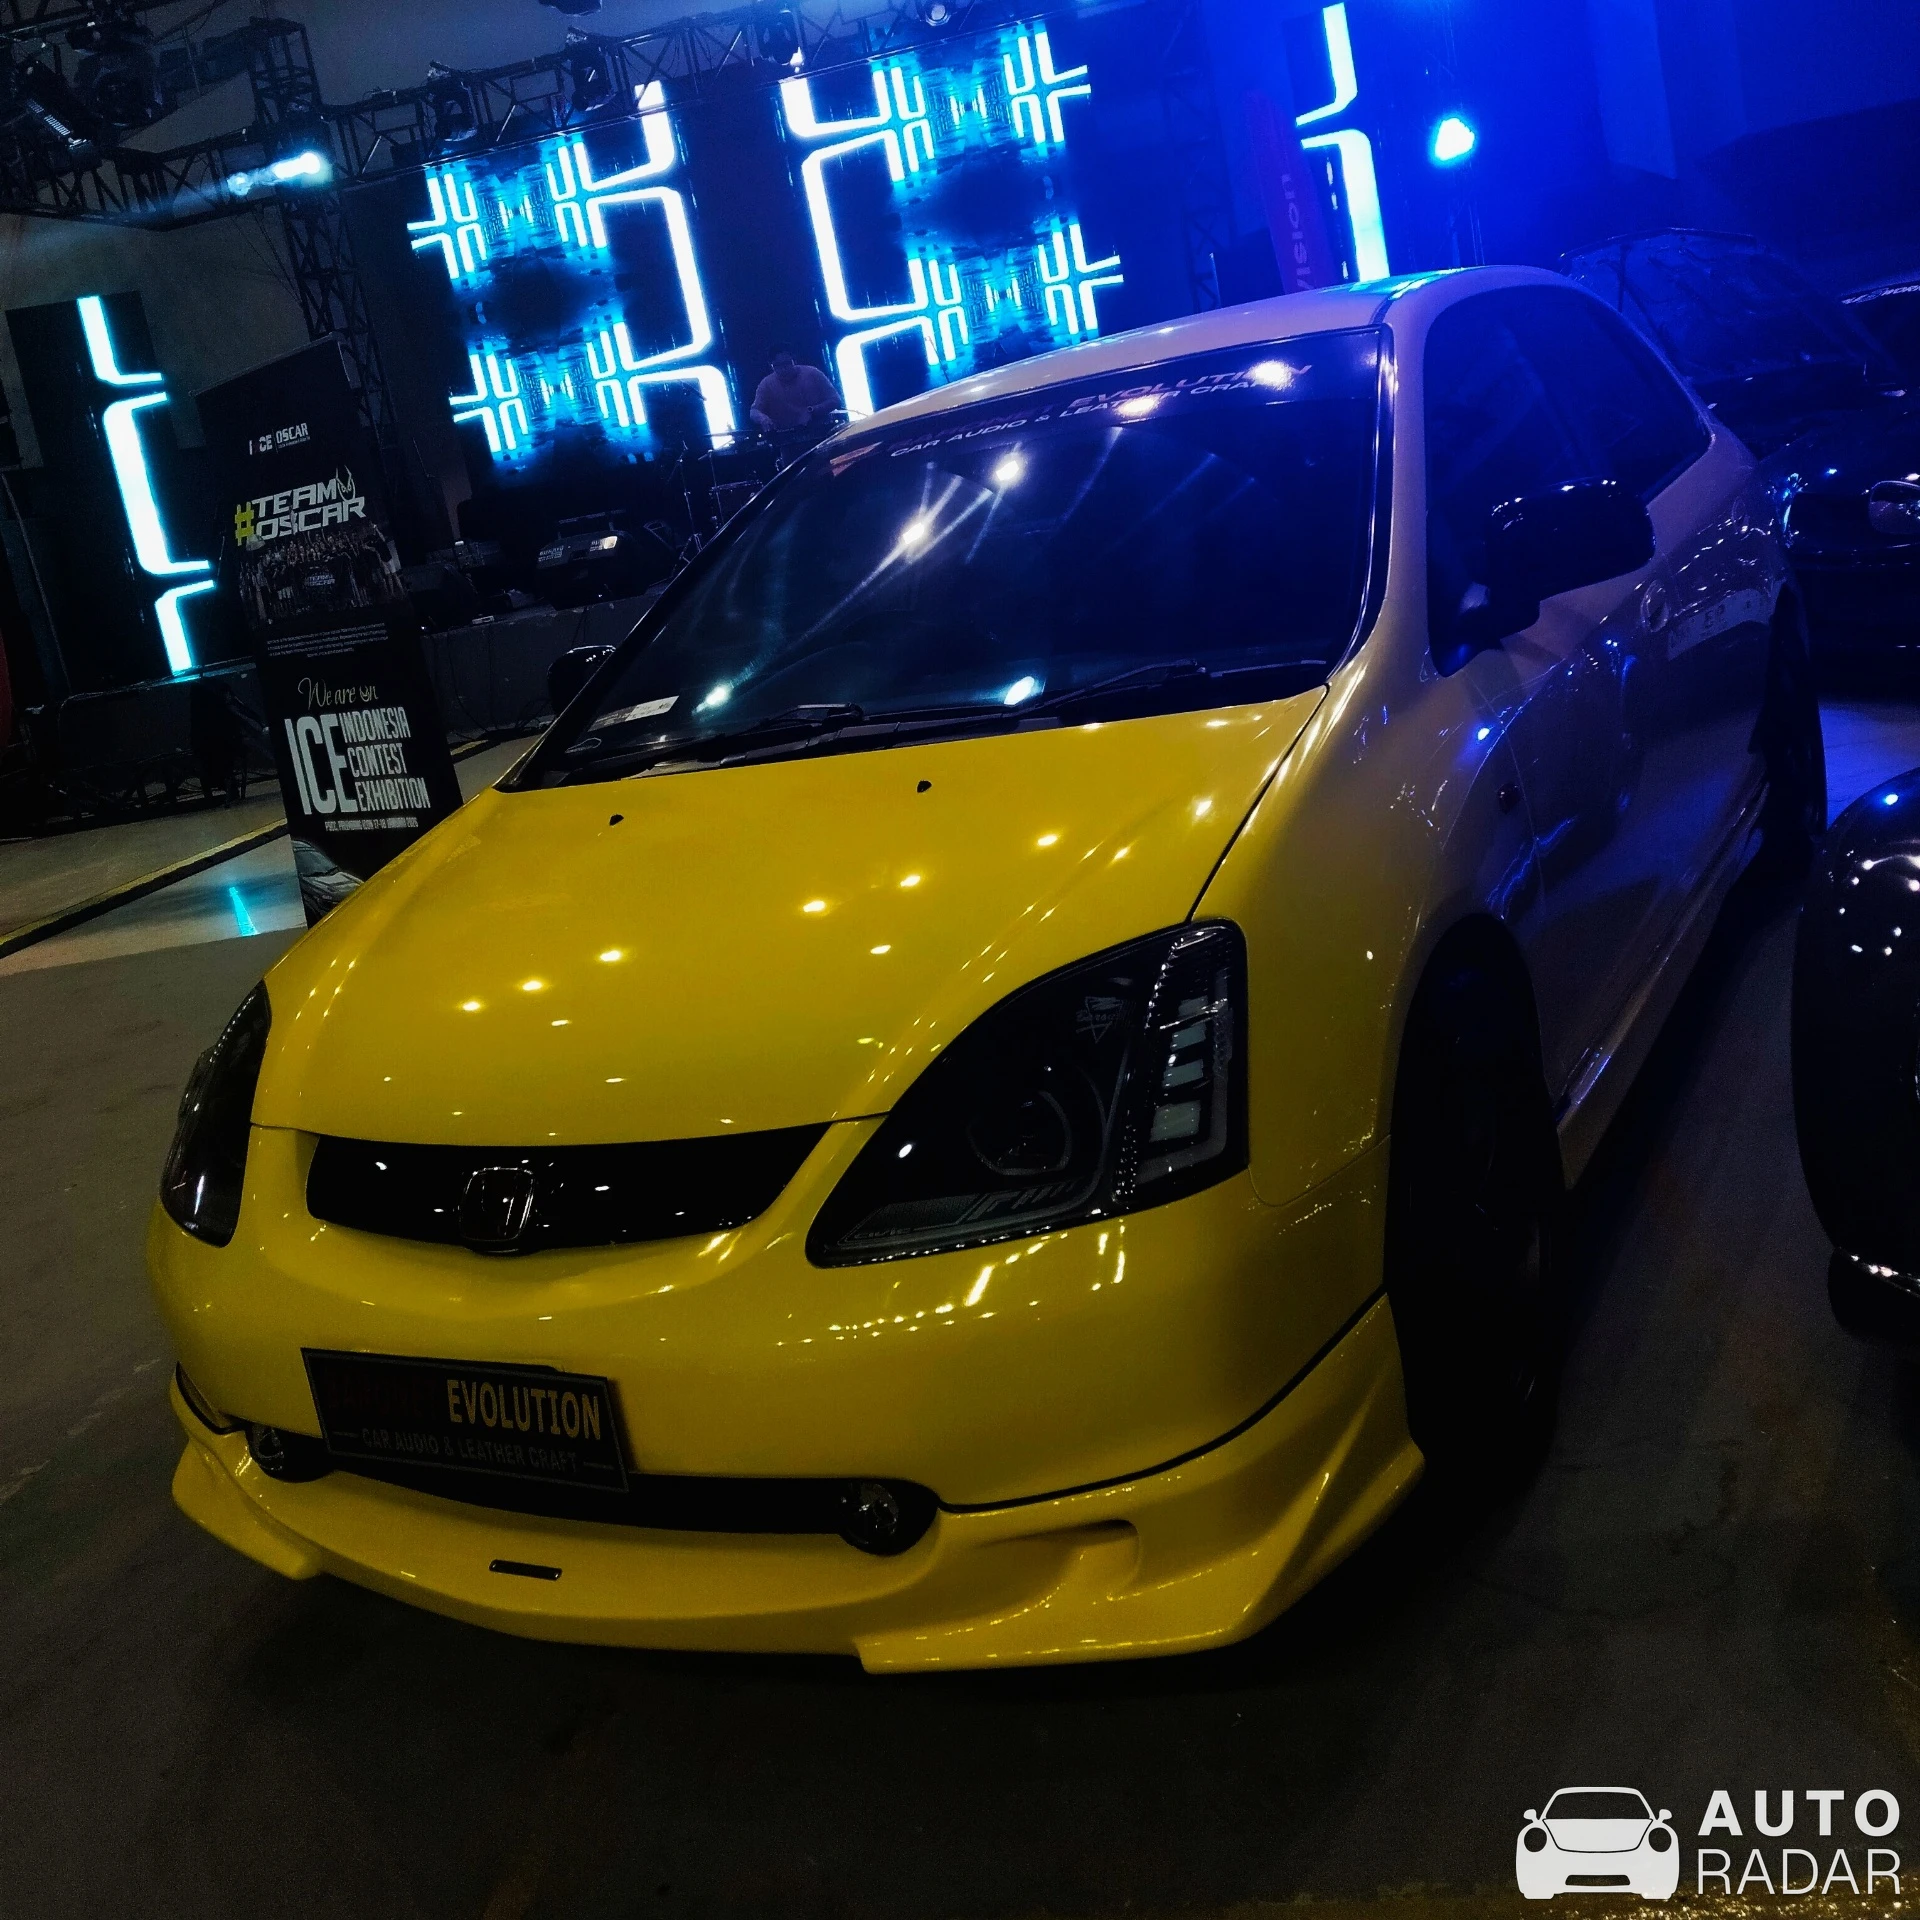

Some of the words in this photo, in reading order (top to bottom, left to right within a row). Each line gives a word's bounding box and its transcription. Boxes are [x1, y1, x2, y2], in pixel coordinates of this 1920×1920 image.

[1068, 364, 1313, 408] EVOLUTIN
[276, 422, 309, 444] OSCAR
[891, 439, 941, 457] CAR
[946, 419, 1028, 443] AUDIO
[1059, 390, 1181, 418] LEATR
[255, 496, 366, 543] OSCAR
[298, 677, 332, 710] We
[335, 686, 357, 705] are
[338, 706, 412, 743] INDONESIA
[284, 713, 358, 815] ICE
[347, 742, 408, 778] CONTEST
[355, 777, 431, 812] EXHIBITION
[446, 1378, 602, 1441] EVOLUTION
[361, 1427, 391, 1451] CAR
[395, 1430, 441, 1455] AUDIO
[457, 1438, 524, 1466] LEATHER
[528, 1446, 578, 1472] CRAFT
